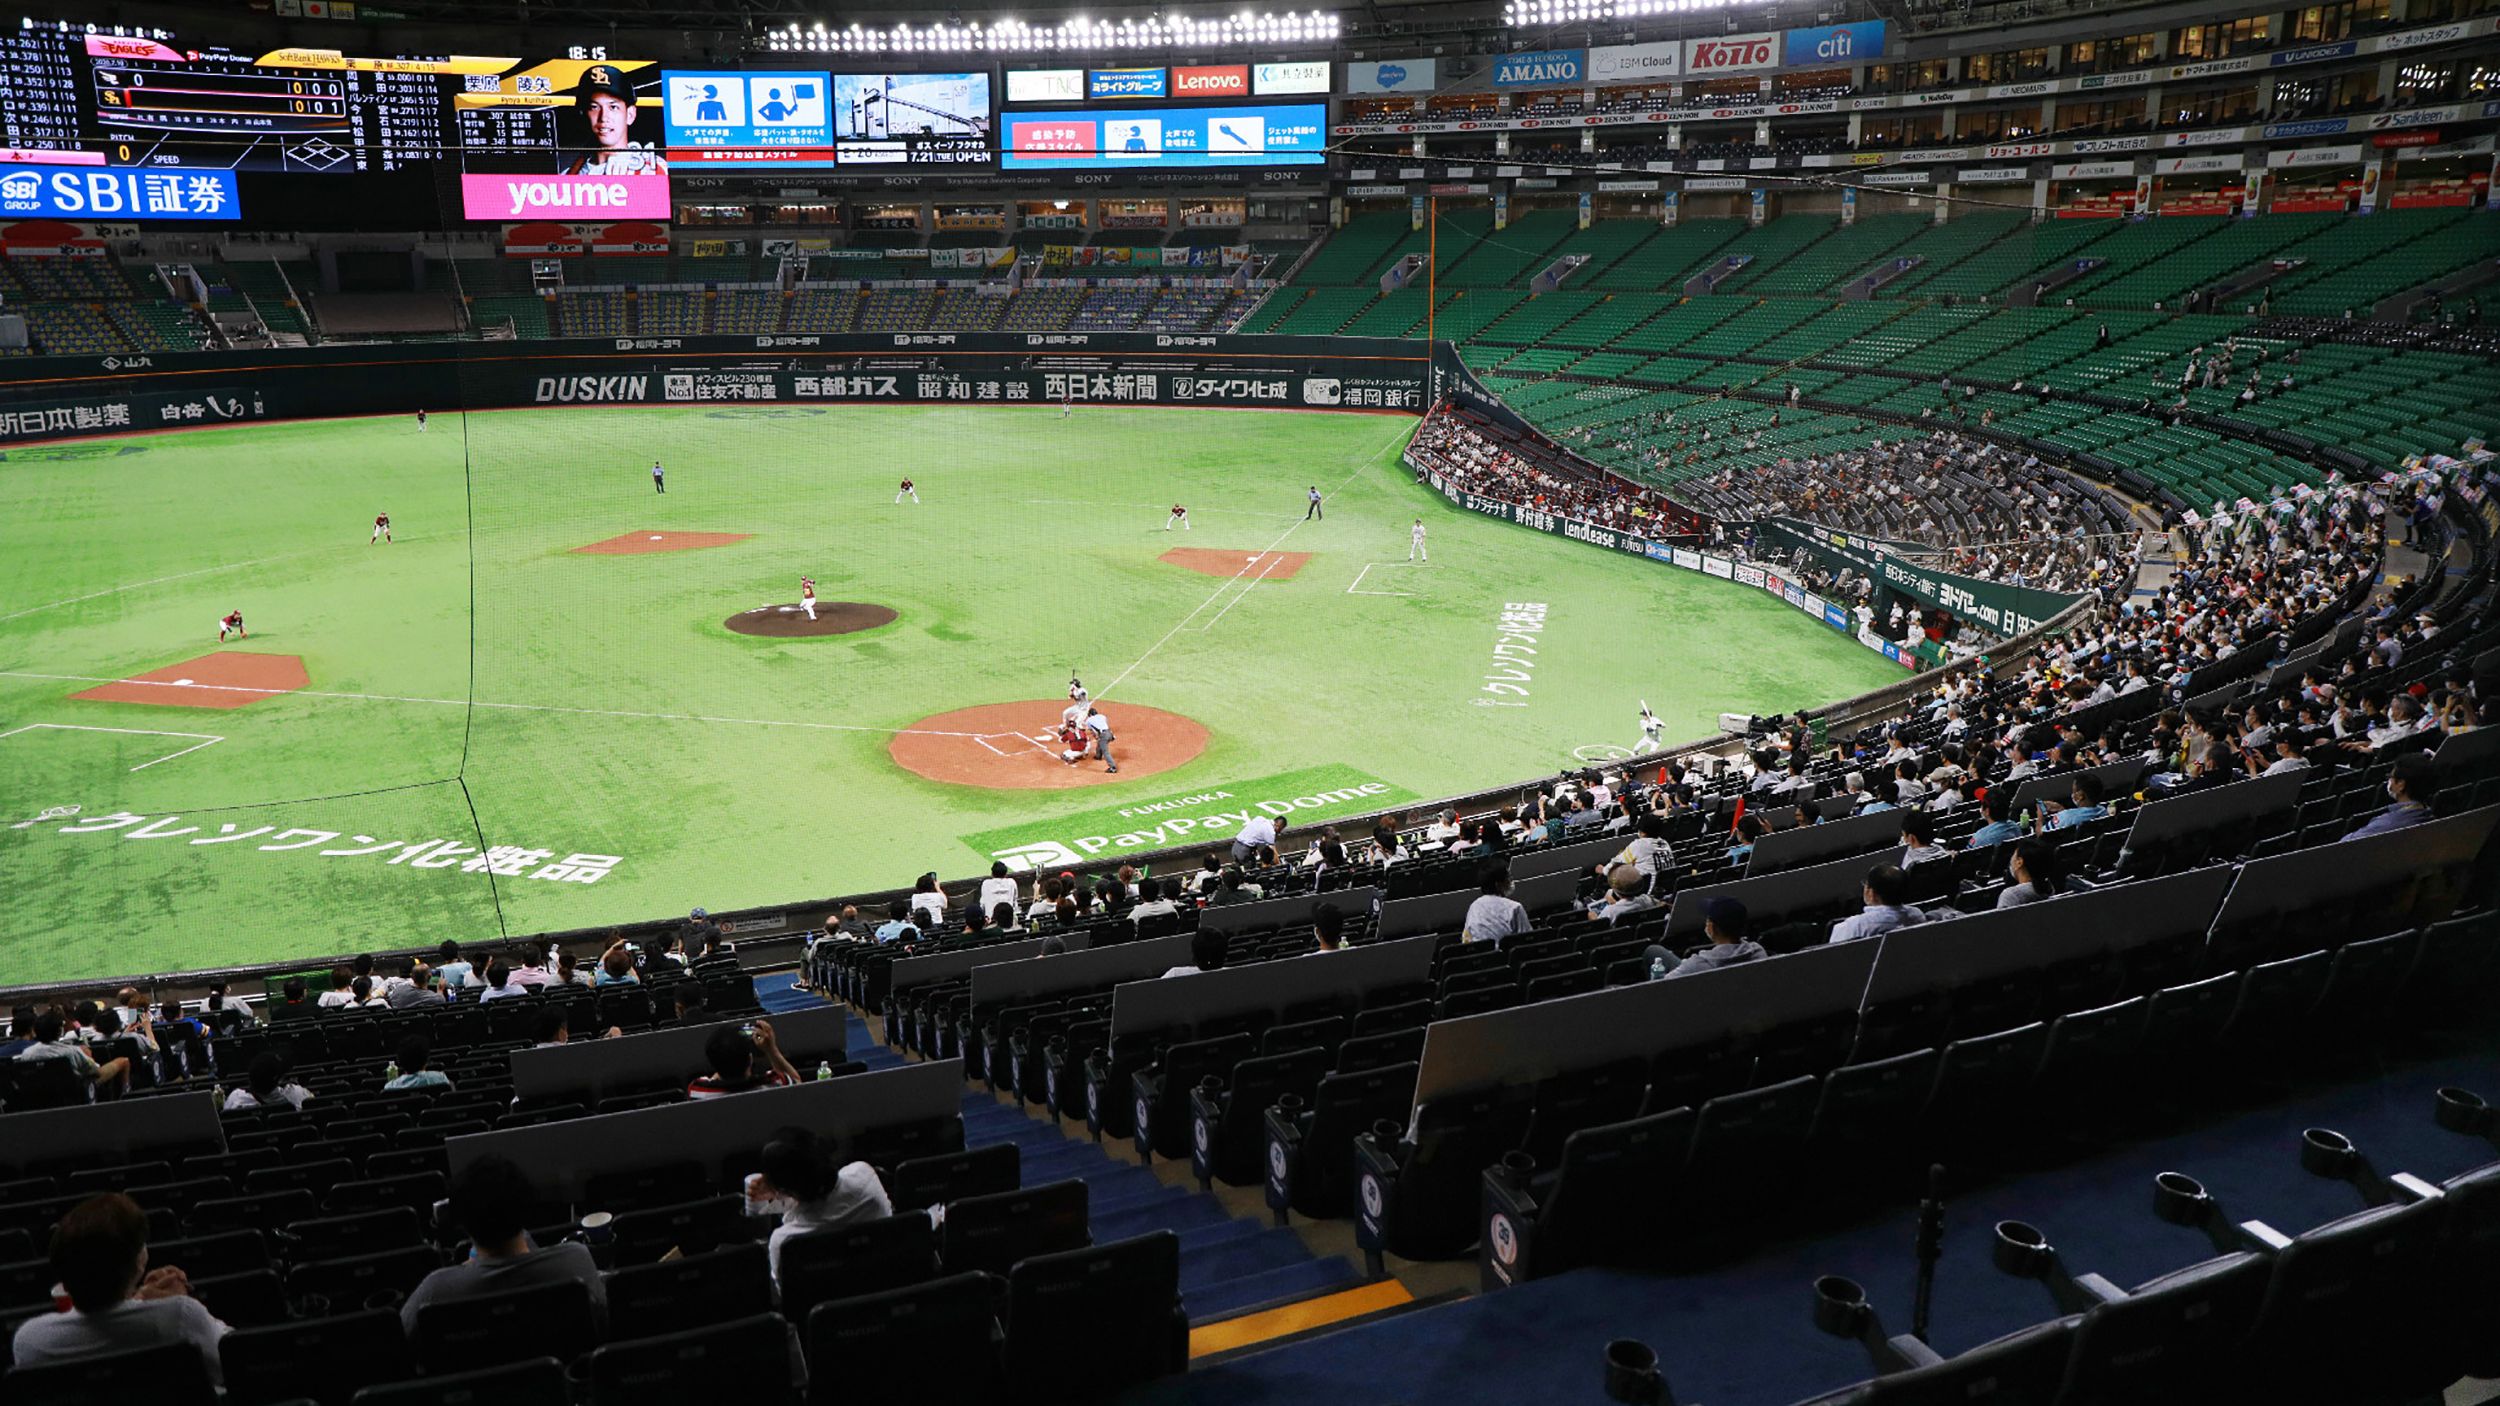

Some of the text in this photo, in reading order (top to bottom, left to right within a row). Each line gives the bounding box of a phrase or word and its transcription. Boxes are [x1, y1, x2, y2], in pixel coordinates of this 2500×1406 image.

[1817, 30, 1852, 58] citi
[200, 53, 228, 62] PayPay
[568, 46, 607, 61] 18:15
[1620, 54, 1672, 69] IBM Cloud
[134, 74, 143, 86] 0
[1498, 62, 1575, 82] AMANO
[293, 82, 337, 96] 0 0 0
[464, 75, 552, 93] 栗原 陵矢
[1092, 82, 1162, 93] ミライトグループ
[296, 101, 337, 113] 0 0 1
[119, 145, 130, 161] 0
[153, 155, 180, 164] SPEED
[911, 152, 934, 162] 7.21
[956, 152, 991, 162] OPEN
[687, 178, 726, 187] SONY
[884, 177, 922, 186] SONY
[1075, 174, 1112, 183] SONY
[1264, 172, 1301, 181] SONY
[53, 173, 226, 214] SBI証券
[507, 182, 628, 215] youme
[4, 201, 42, 211] GROUP
[124, 356, 153, 368] 山九
[695, 384, 777, 399] 住友不動産
[794, 377, 900, 396] 西部ガス
[917, 382, 1029, 400] 昭和建設
[1044, 374, 1158, 400] 西日本新聞
[1195, 380, 1287, 399] ダイワ化成
[1344, 388, 1422, 407] 福岡銀行
[1473, 497, 1500, 515] プラチナ
[1515, 506, 1555, 532] 野村證券
[1564, 519, 1616, 548] Lendlease
[1621, 537, 1644, 553] FUJITSU
[1885, 563, 1937, 598] 西日本シティ銀行
[1939, 582, 1999, 626] ヨドバシ.com
[1118, 789, 1235, 818] FUKUOKA
[1073, 780, 1391, 855] PayPay Dome
